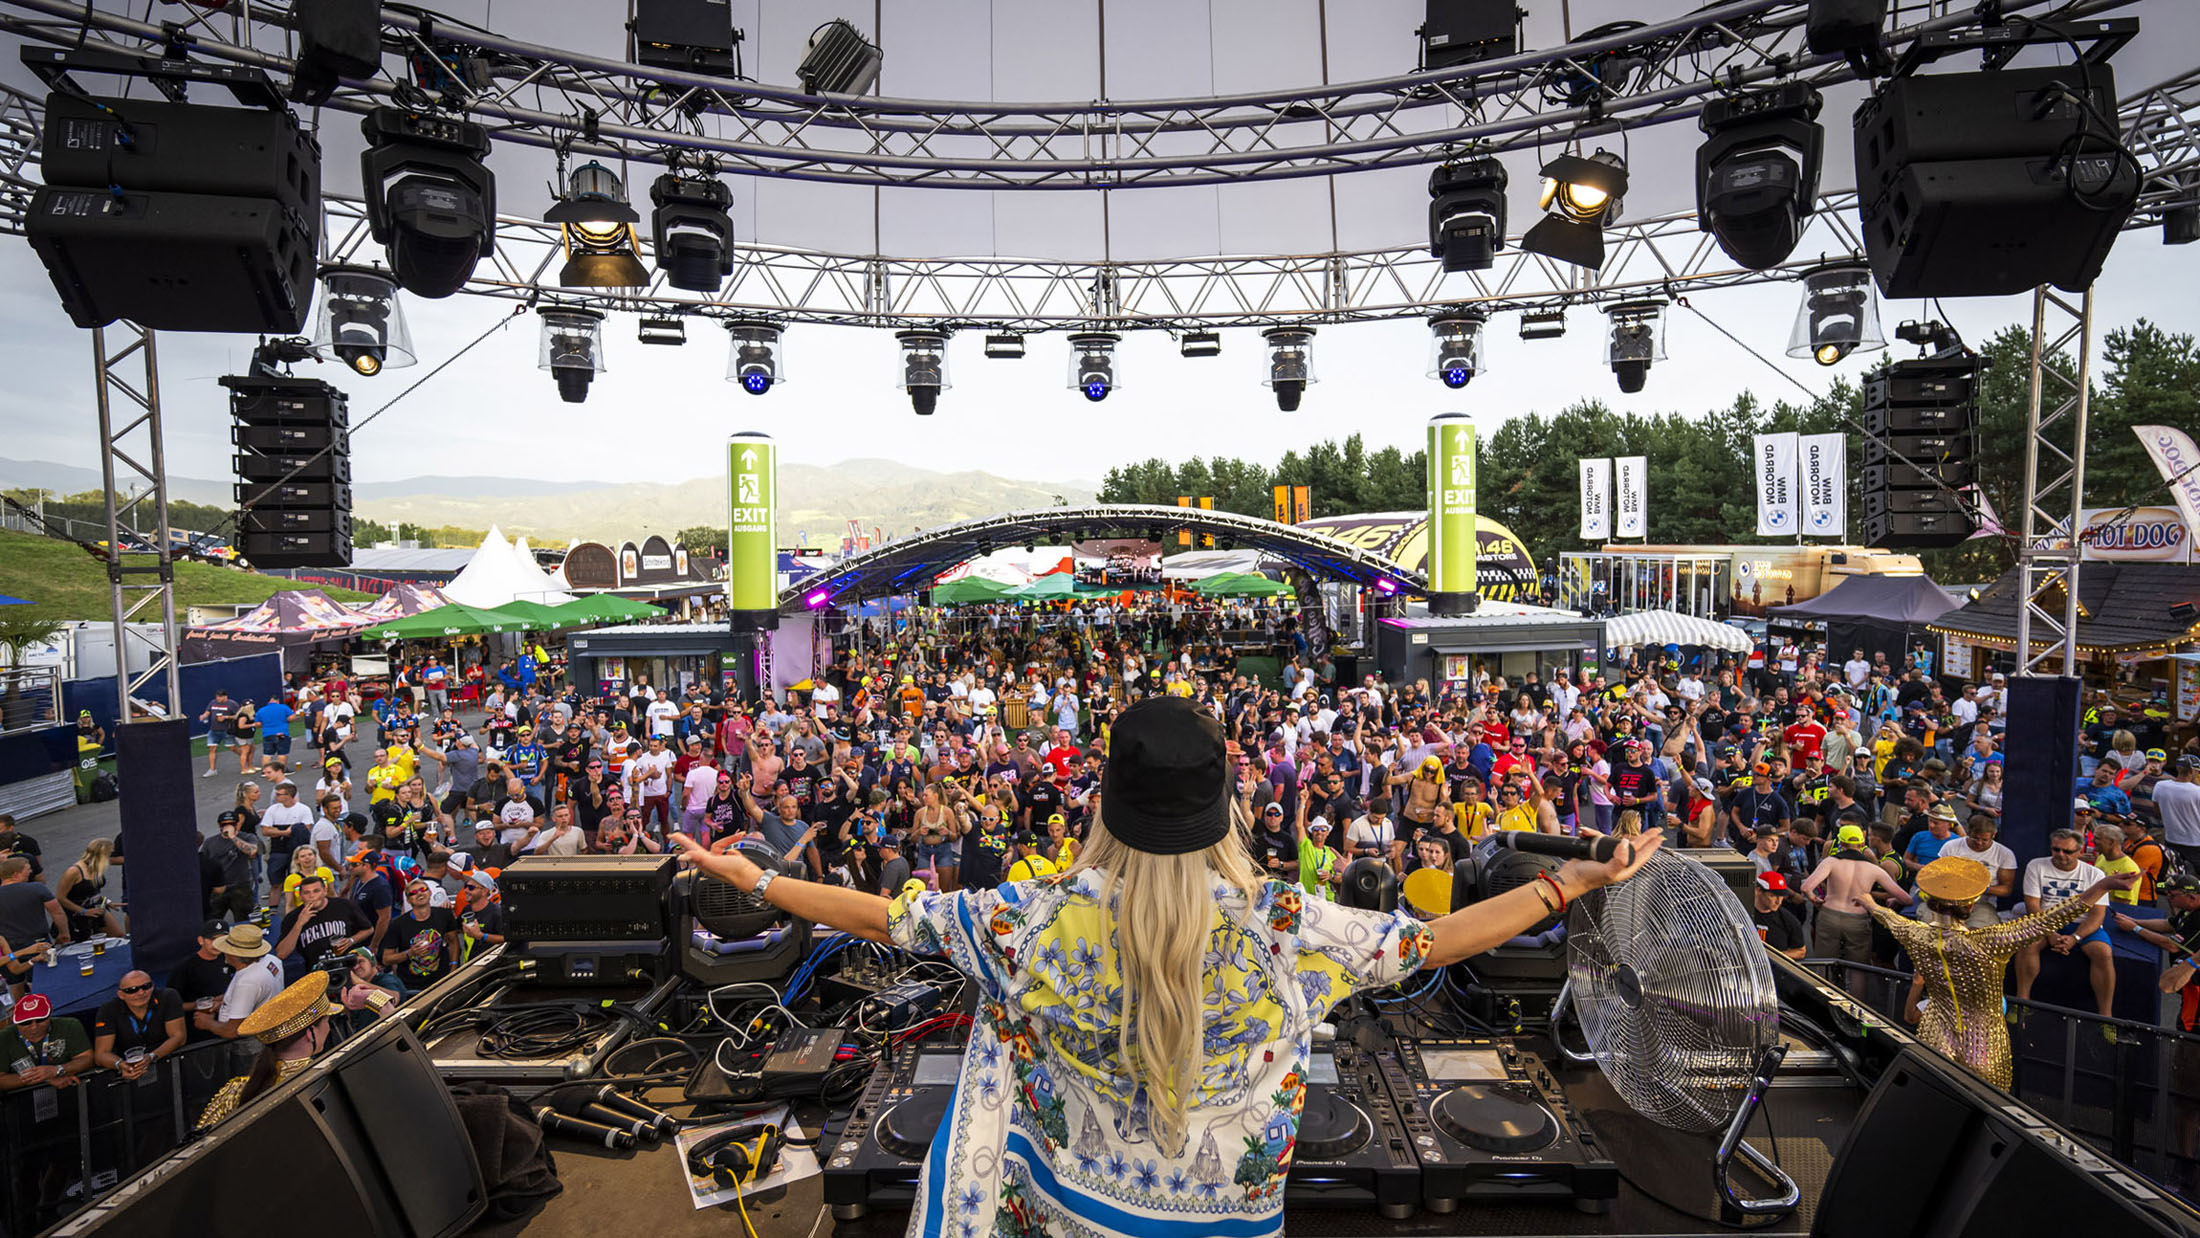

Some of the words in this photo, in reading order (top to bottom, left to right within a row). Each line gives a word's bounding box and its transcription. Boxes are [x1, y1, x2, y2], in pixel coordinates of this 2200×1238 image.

[1444, 490, 1475, 505] EXIT
[733, 507, 768, 523] EXIT
[734, 525, 767, 533] AUSGANG
[2089, 523, 2129, 547] HOT
[2133, 523, 2179, 547] DOG
[300, 920, 346, 948] PEGADOR
